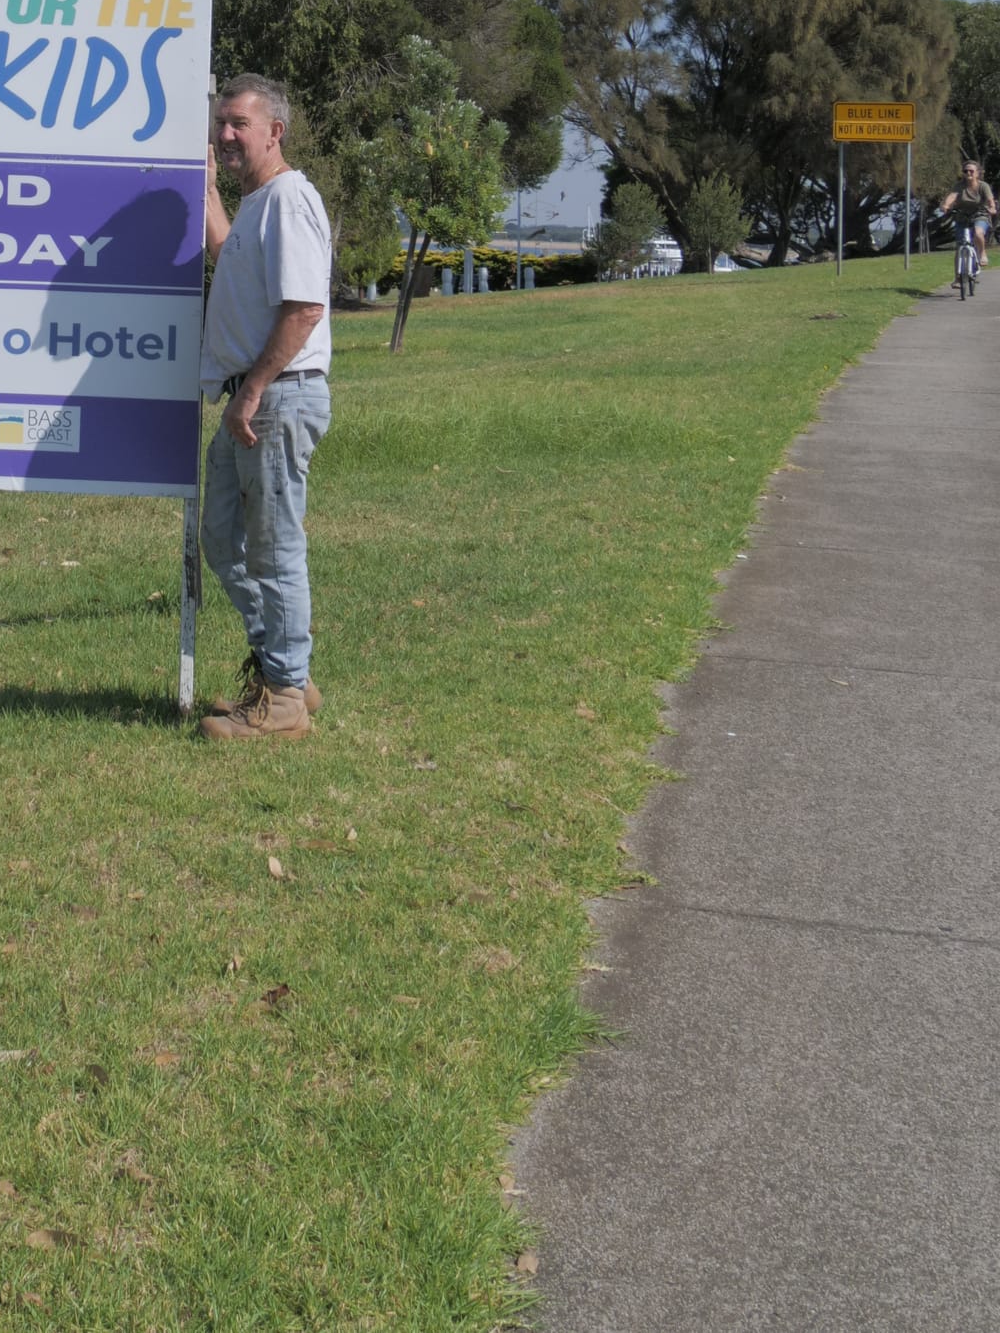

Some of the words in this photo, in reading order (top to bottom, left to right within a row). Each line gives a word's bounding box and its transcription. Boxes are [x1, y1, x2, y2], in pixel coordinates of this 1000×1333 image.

[847, 108, 873, 119] BLUE
[878, 108, 901, 119] LINE
[838, 125, 853, 134] NOT
[856, 125, 864, 134] IN
[867, 125, 911, 135] OPERATION
[48, 322, 177, 362] Hotel
[27, 409, 73, 428] BASS
[27, 428, 72, 441] COAST
